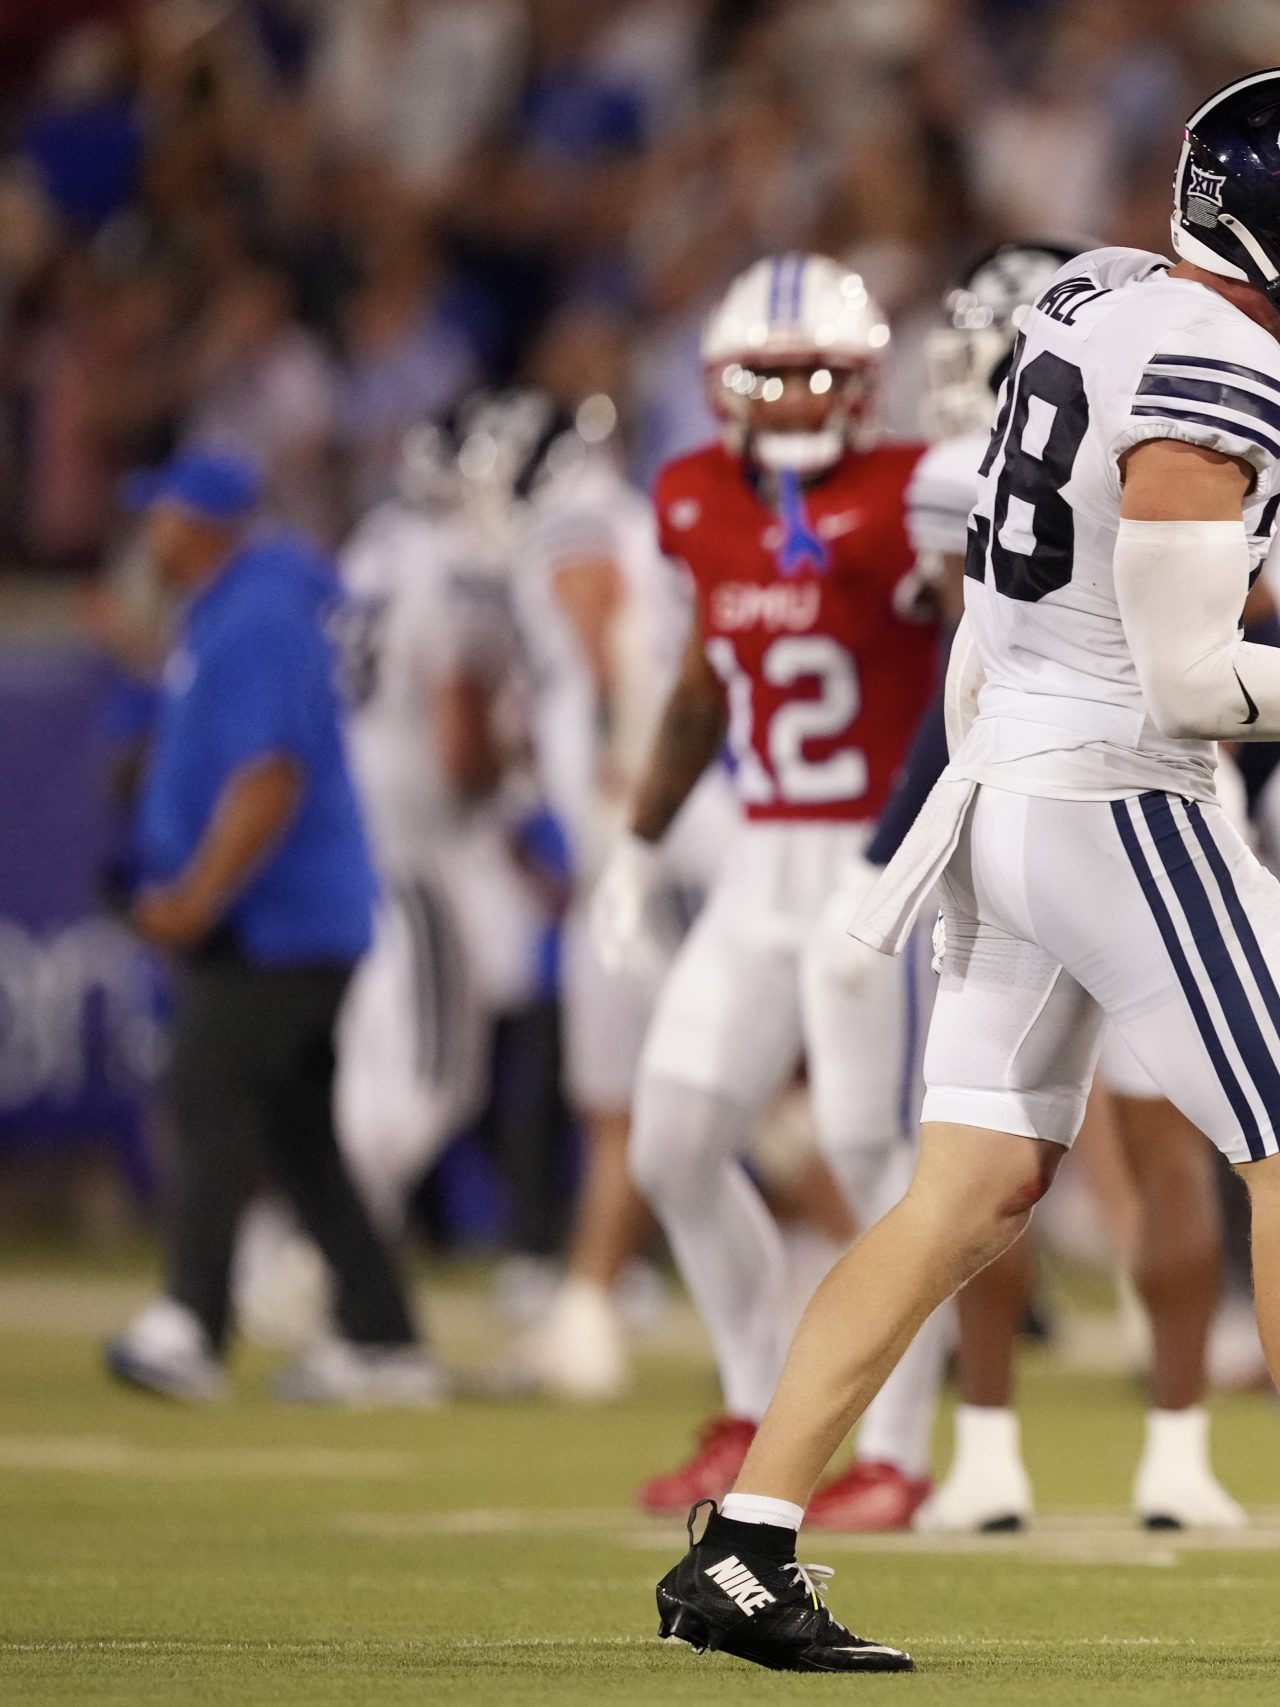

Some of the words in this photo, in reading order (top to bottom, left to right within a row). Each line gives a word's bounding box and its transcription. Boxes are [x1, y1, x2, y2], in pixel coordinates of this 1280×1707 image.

[1036, 277, 1113, 327] ALL
[706, 636, 868, 804] 12
[704, 1555, 776, 1617] NIKE
